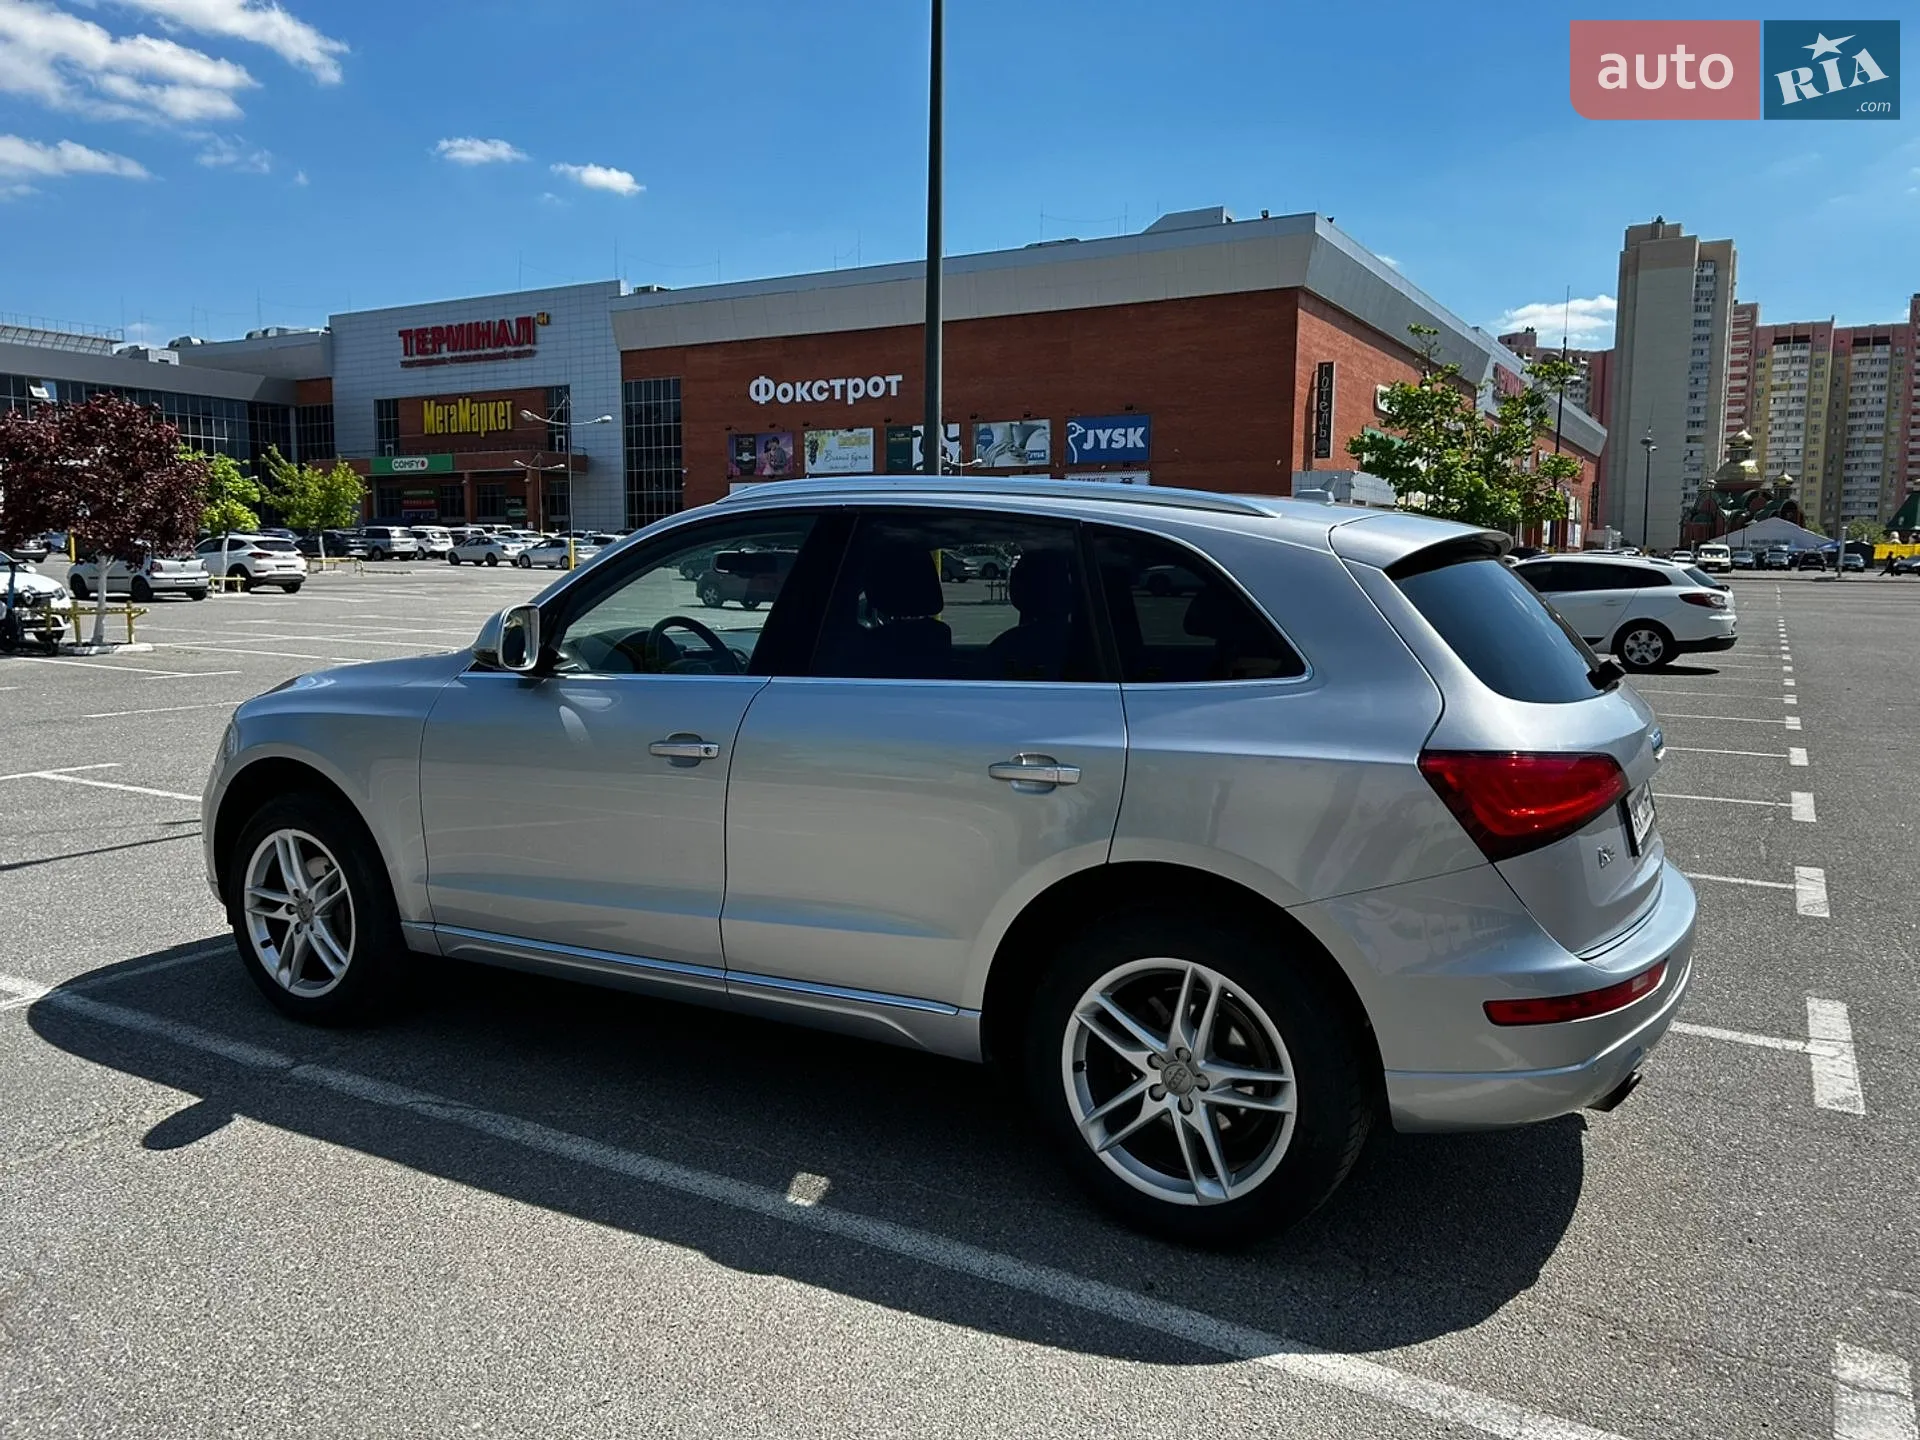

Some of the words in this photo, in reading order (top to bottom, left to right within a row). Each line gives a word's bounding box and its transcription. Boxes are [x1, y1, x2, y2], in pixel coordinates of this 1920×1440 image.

[399, 316, 536, 357] ТЕРМІНАЛ
[749, 374, 903, 405] Фокстрот
[423, 397, 513, 437] МегаМаркет
[1082, 426, 1146, 451] JYSK
[394, 459, 420, 469] COMFY
